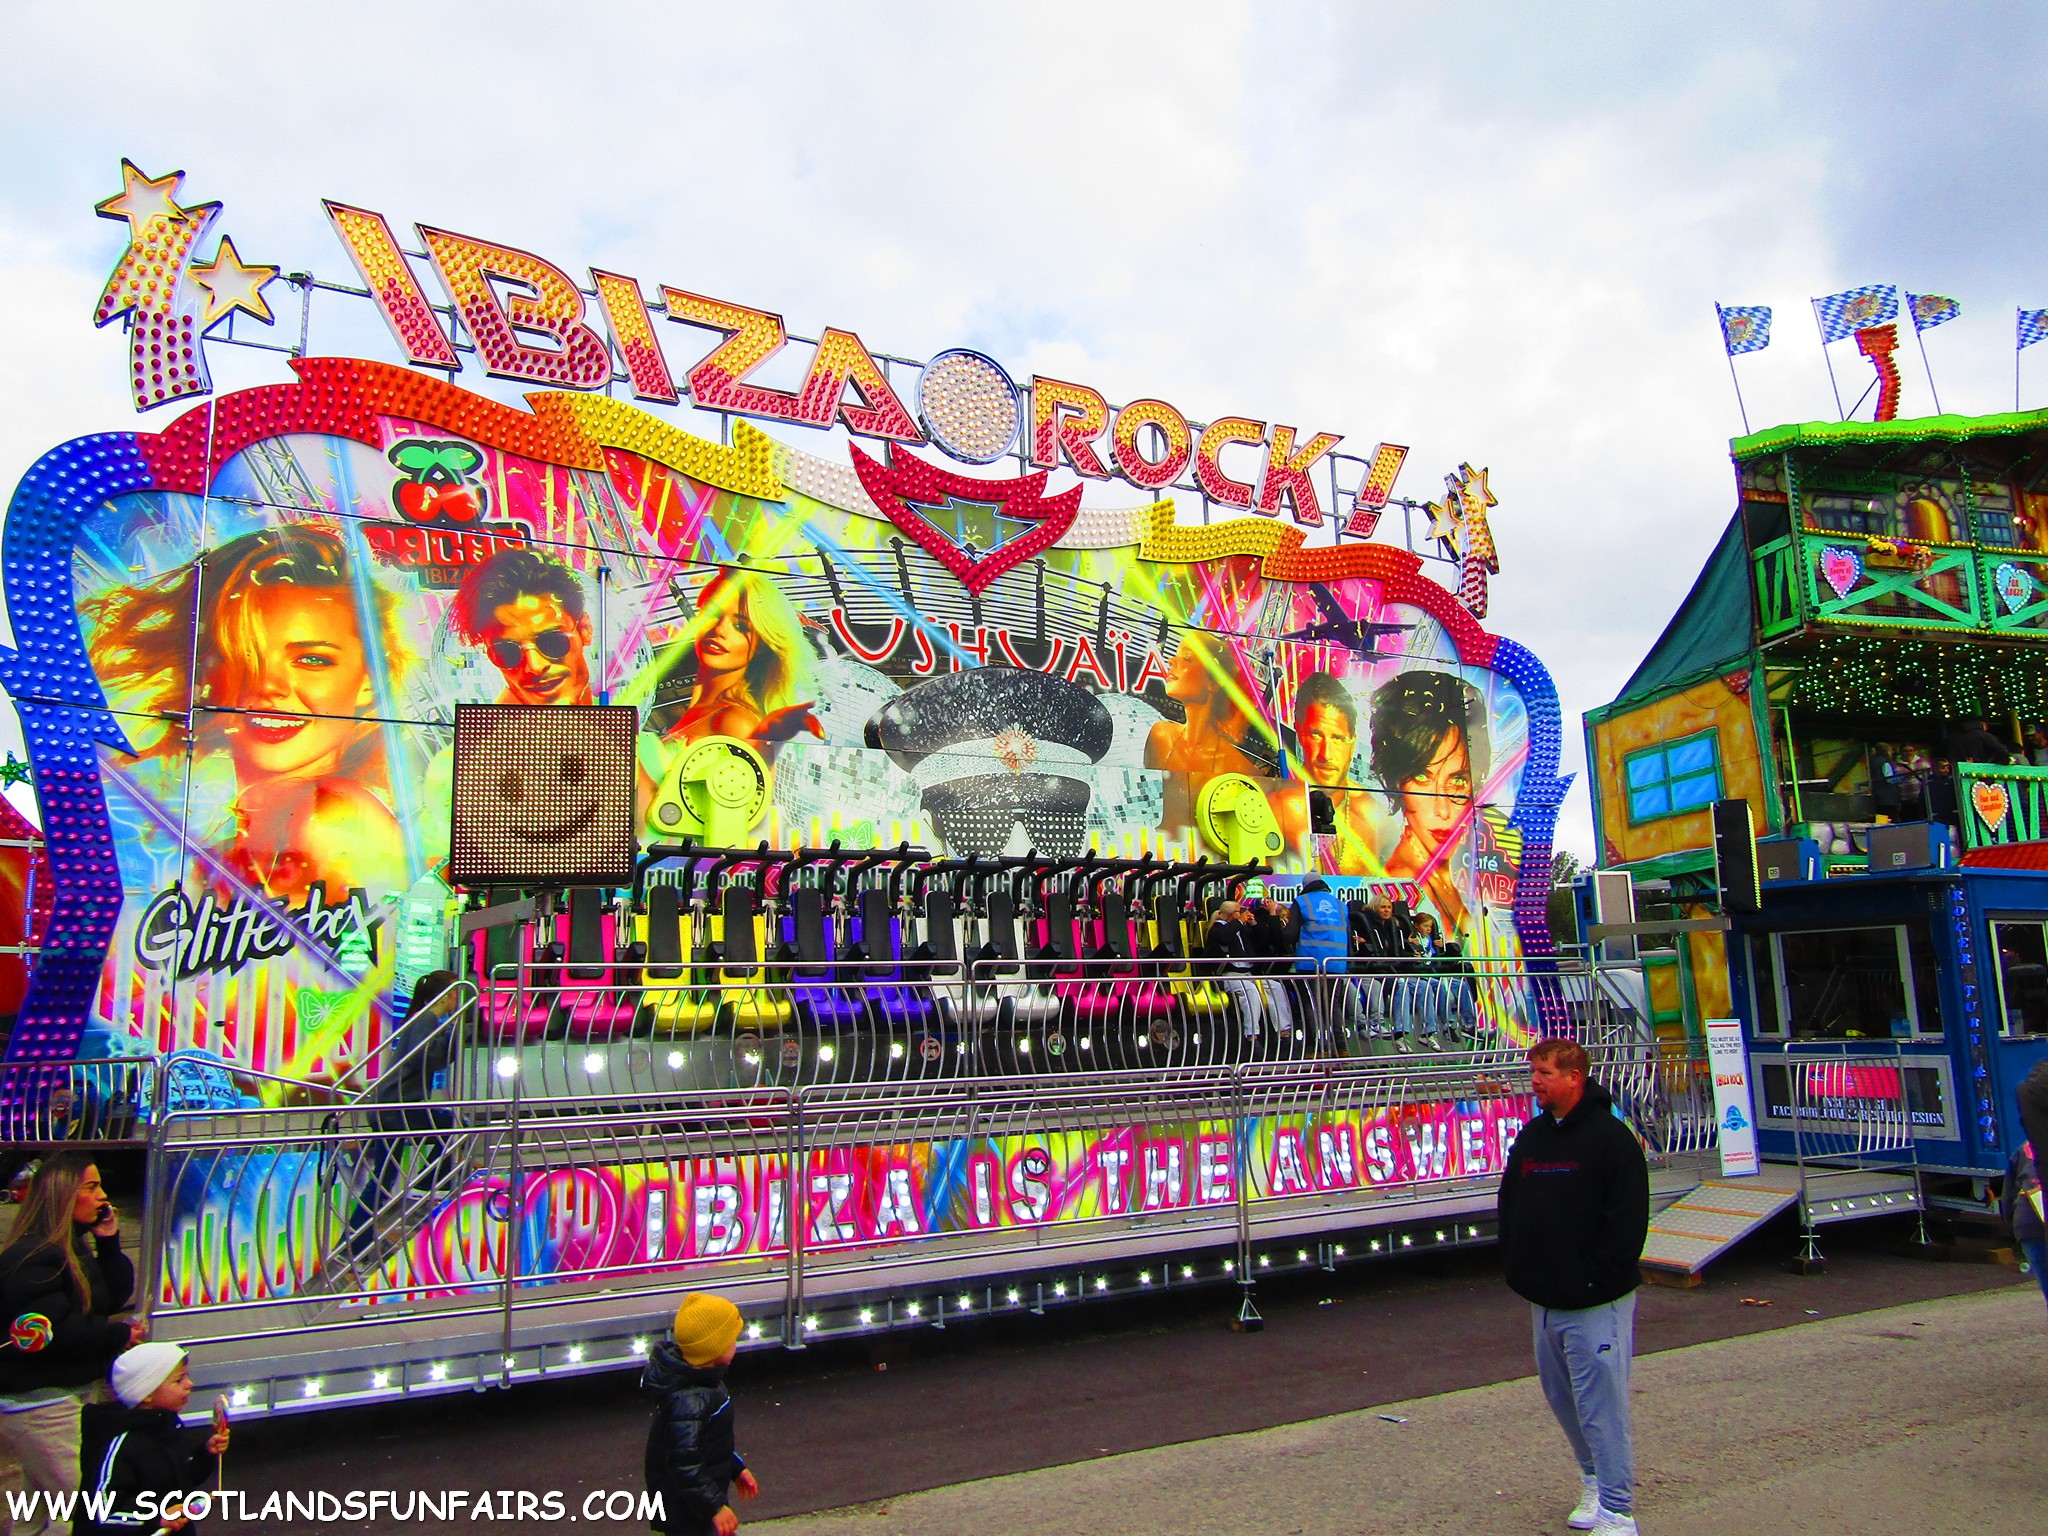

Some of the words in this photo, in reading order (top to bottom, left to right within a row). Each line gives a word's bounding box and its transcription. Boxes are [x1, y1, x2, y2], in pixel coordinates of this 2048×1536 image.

[321, 198, 927, 442] IBIZA
[1456, 868, 1518, 905] AMB
[1462, 853, 1499, 872] Café
[137, 883, 380, 978] Glitterbox
[1963, 985, 1982, 1045] TUBY
[144, 1084, 232, 1101] FNFAIRS
[646, 1169, 918, 1262] IBIZA
[975, 1157, 1050, 1225] IS
[1096, 1142, 1233, 1212] THE
[1273, 1116, 1522, 1192] ANSWER
